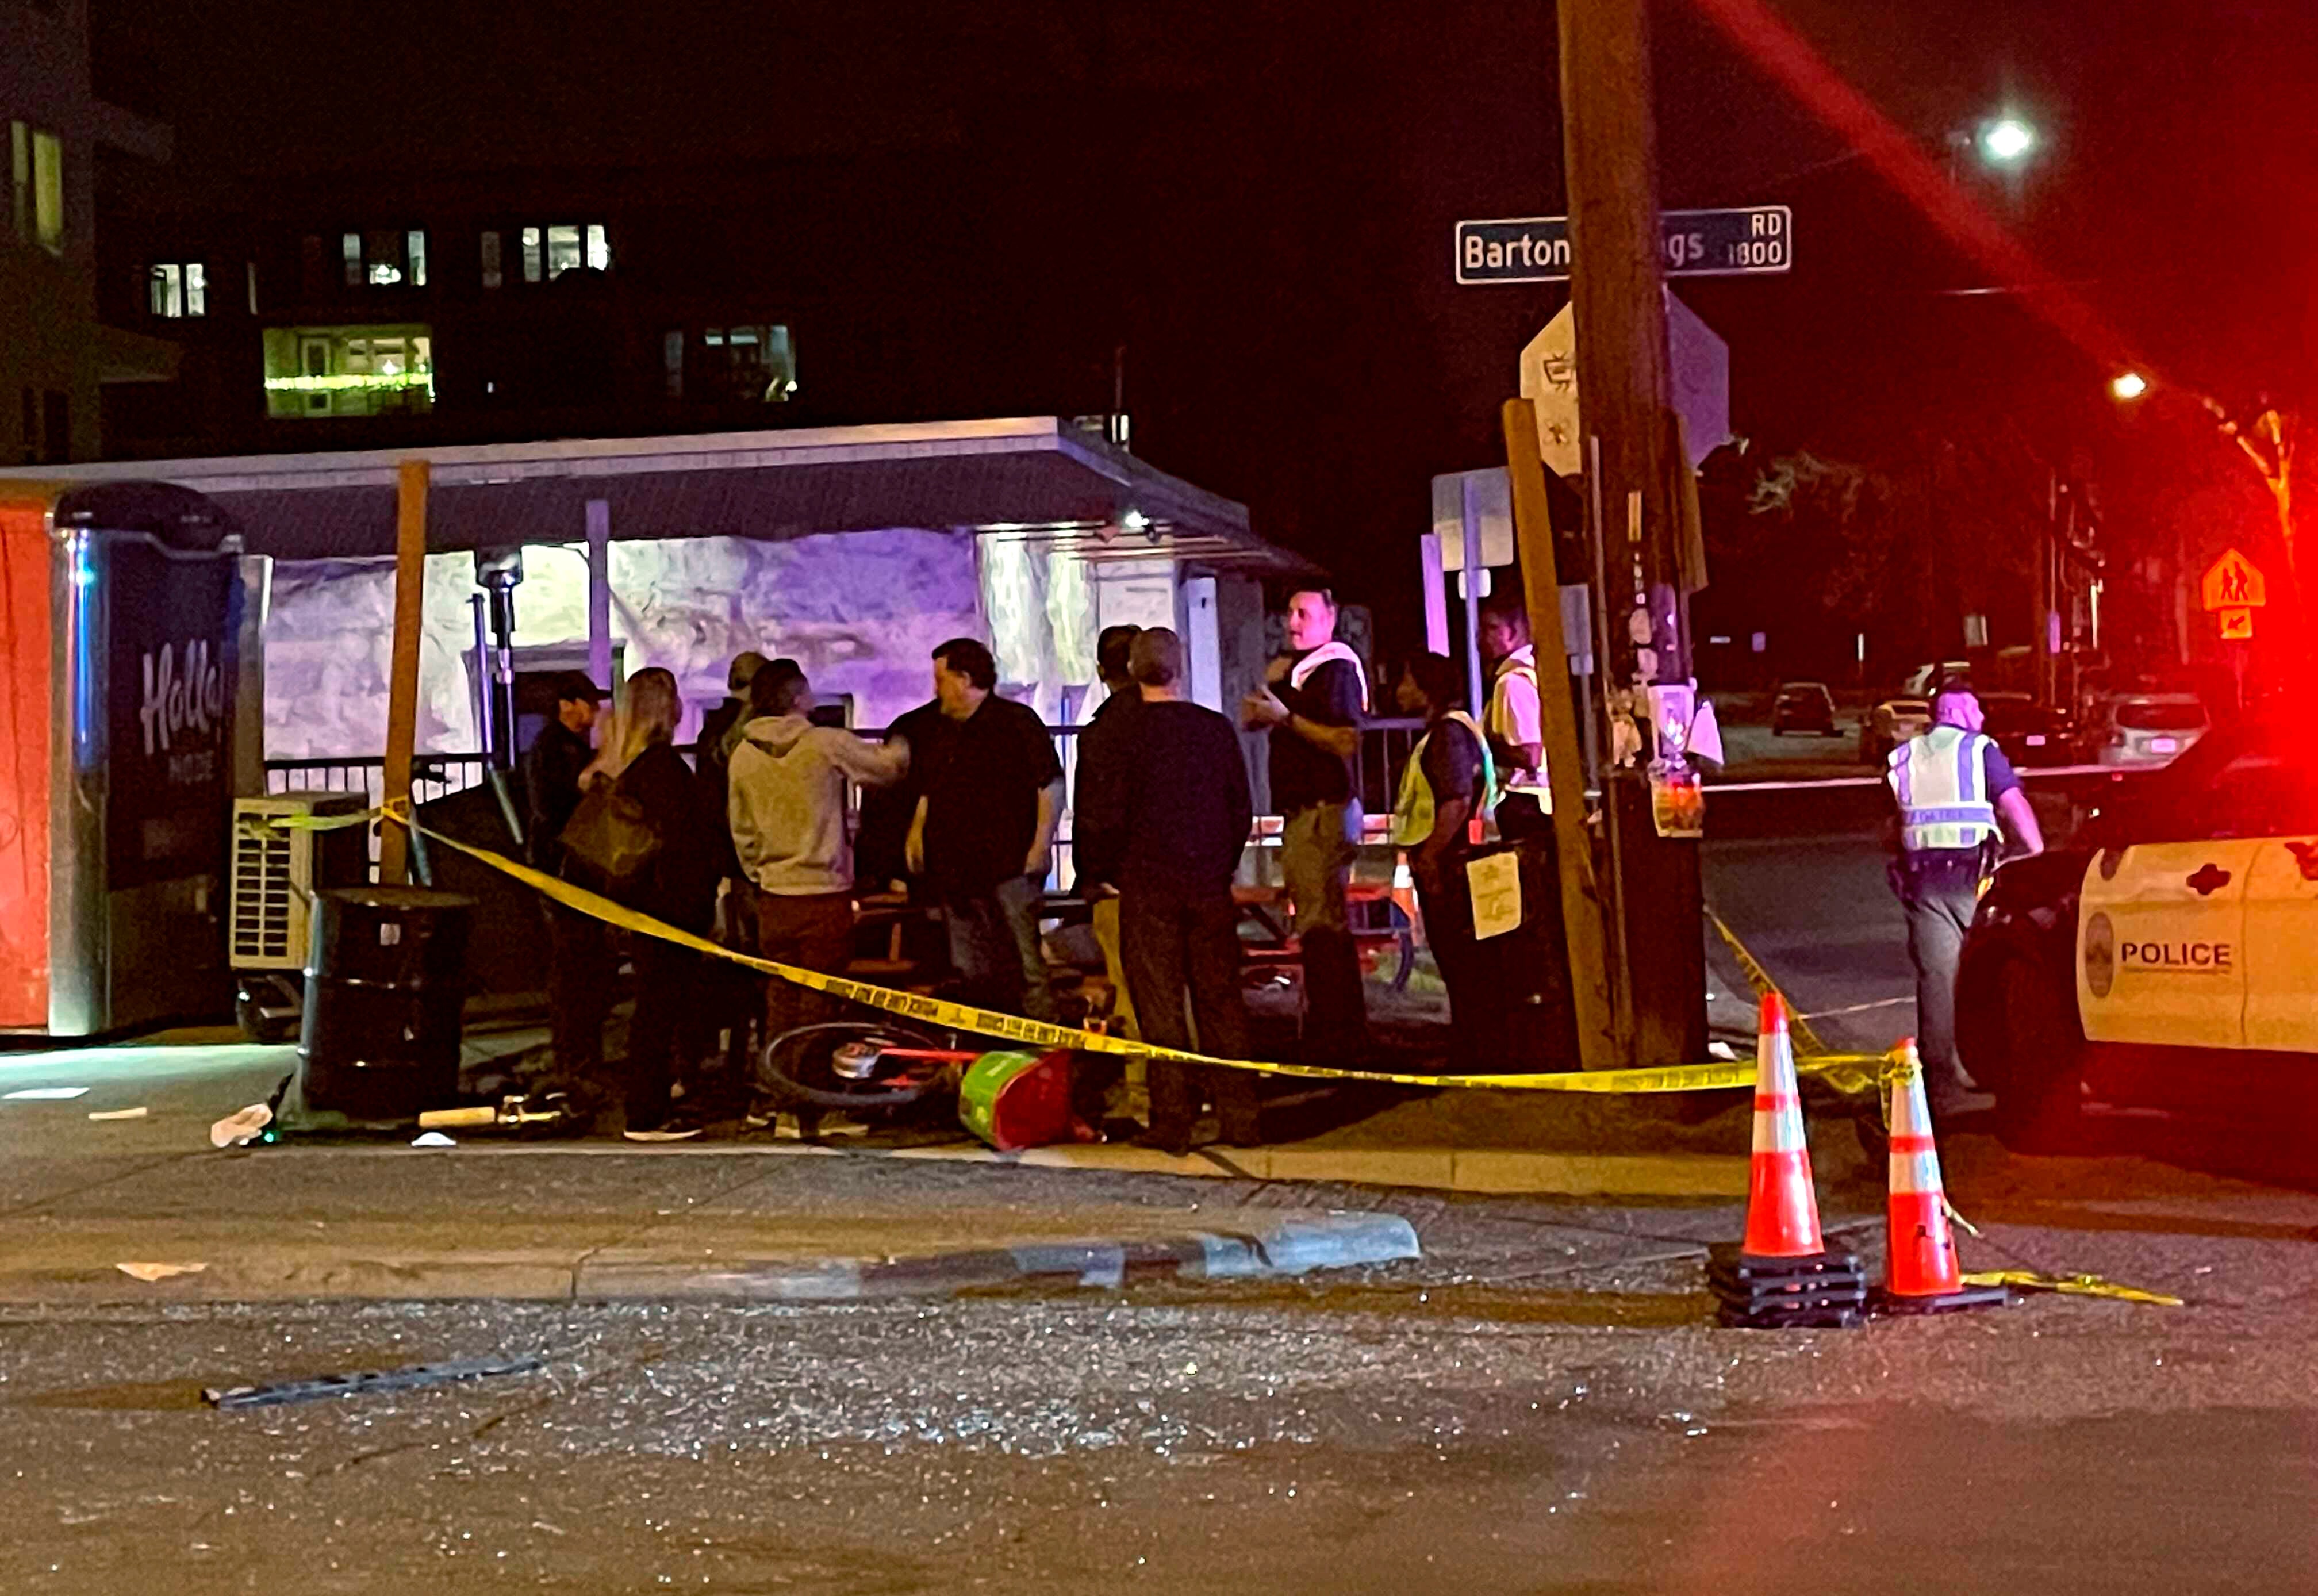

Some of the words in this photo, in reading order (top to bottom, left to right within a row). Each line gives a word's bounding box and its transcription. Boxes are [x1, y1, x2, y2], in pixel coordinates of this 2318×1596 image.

[1752, 213, 1782, 238] RD
[1466, 234, 1570, 268] Barton
[1729, 241, 1782, 265] 1800
[2121, 942, 2232, 966] POLICE
